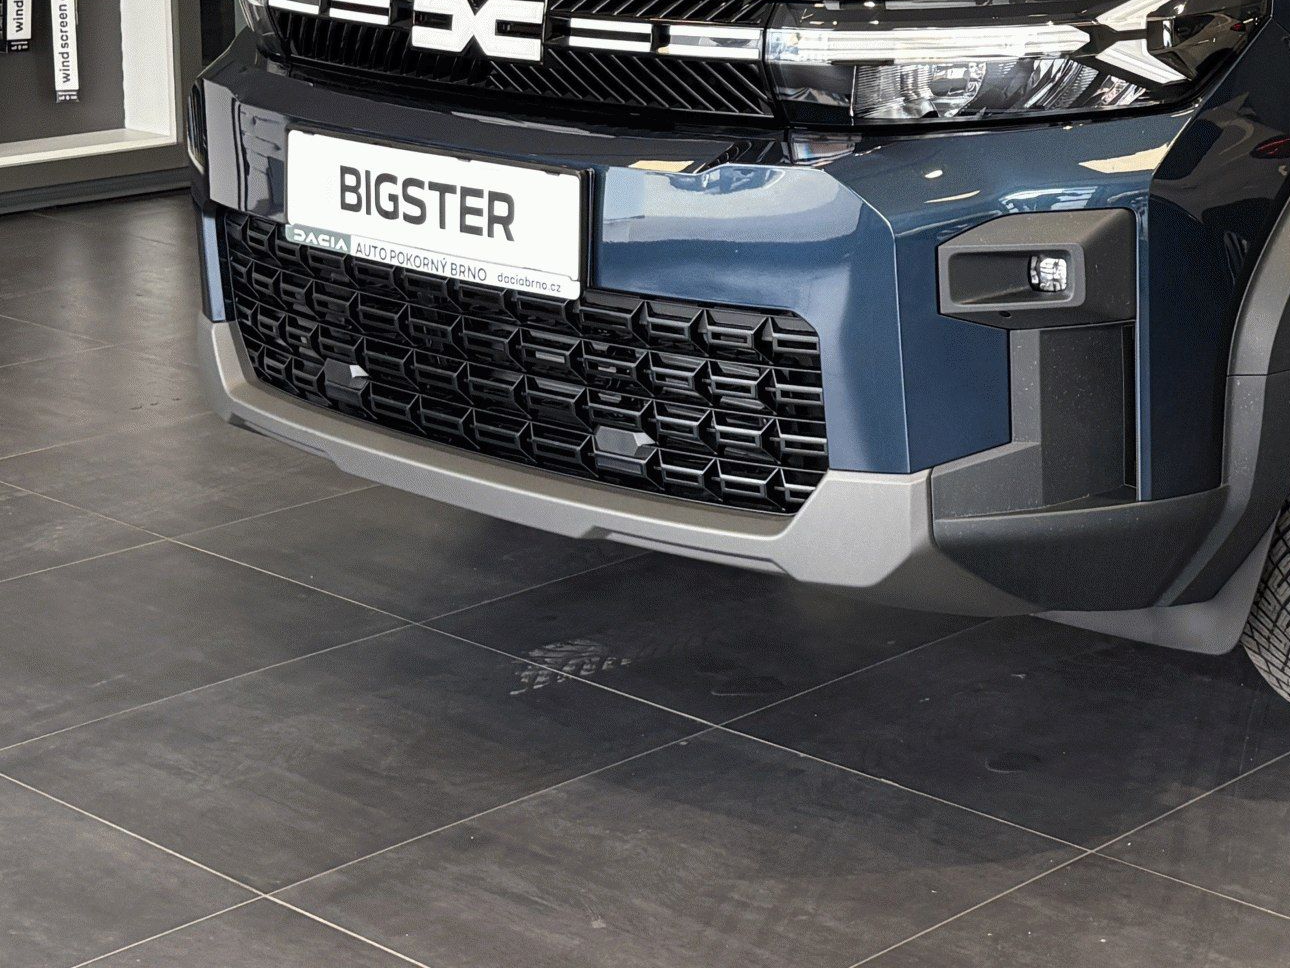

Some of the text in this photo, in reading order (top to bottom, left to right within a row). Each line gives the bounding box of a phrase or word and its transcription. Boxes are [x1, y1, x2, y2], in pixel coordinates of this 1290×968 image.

[14, 0, 25, 33] wind
[59, 3, 70, 49] screen
[60, 50, 71, 84] wind
[339, 165, 515, 242] BIGSTER
[293, 229, 562, 293] DACIA AUTO POKORNÝ BRNO daciabrno.cz
